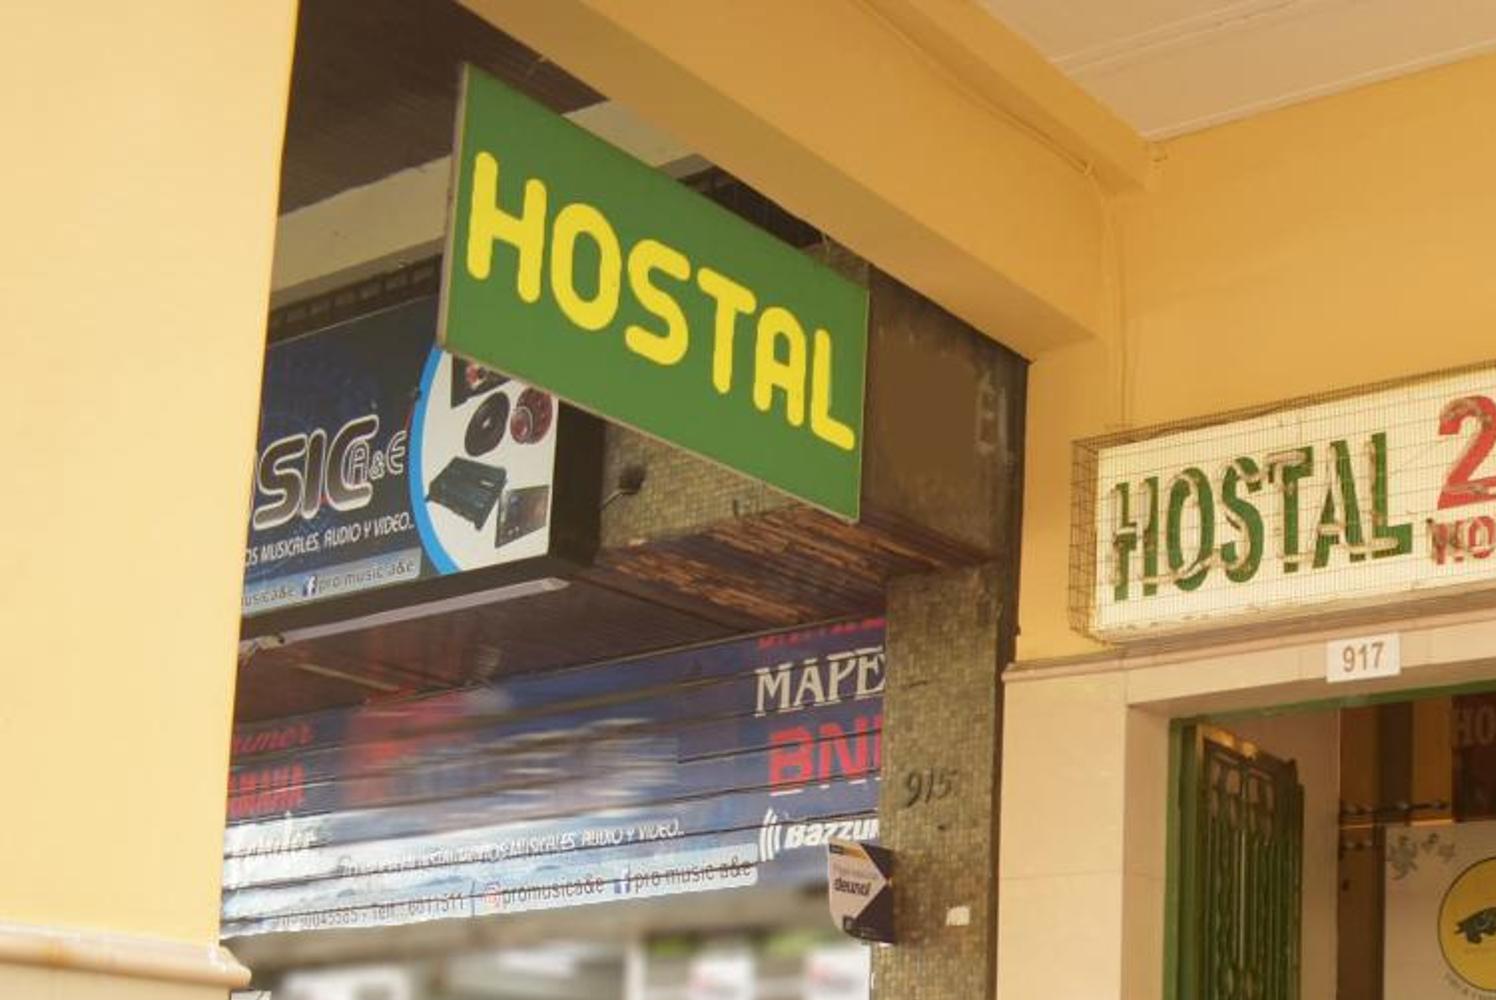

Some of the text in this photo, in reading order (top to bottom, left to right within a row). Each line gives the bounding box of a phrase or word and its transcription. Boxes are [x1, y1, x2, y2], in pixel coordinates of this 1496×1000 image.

[467, 152, 855, 451] HOSTAL
[1112, 432, 1413, 600] HOSTAL
[324, 523, 361, 547] AUDIO
[364, 520, 373, 539] Y
[344, 564, 384, 587] music
[1342, 642, 1384, 673] 917
[906, 767, 958, 808] 915
[666, 861, 714, 884] music
